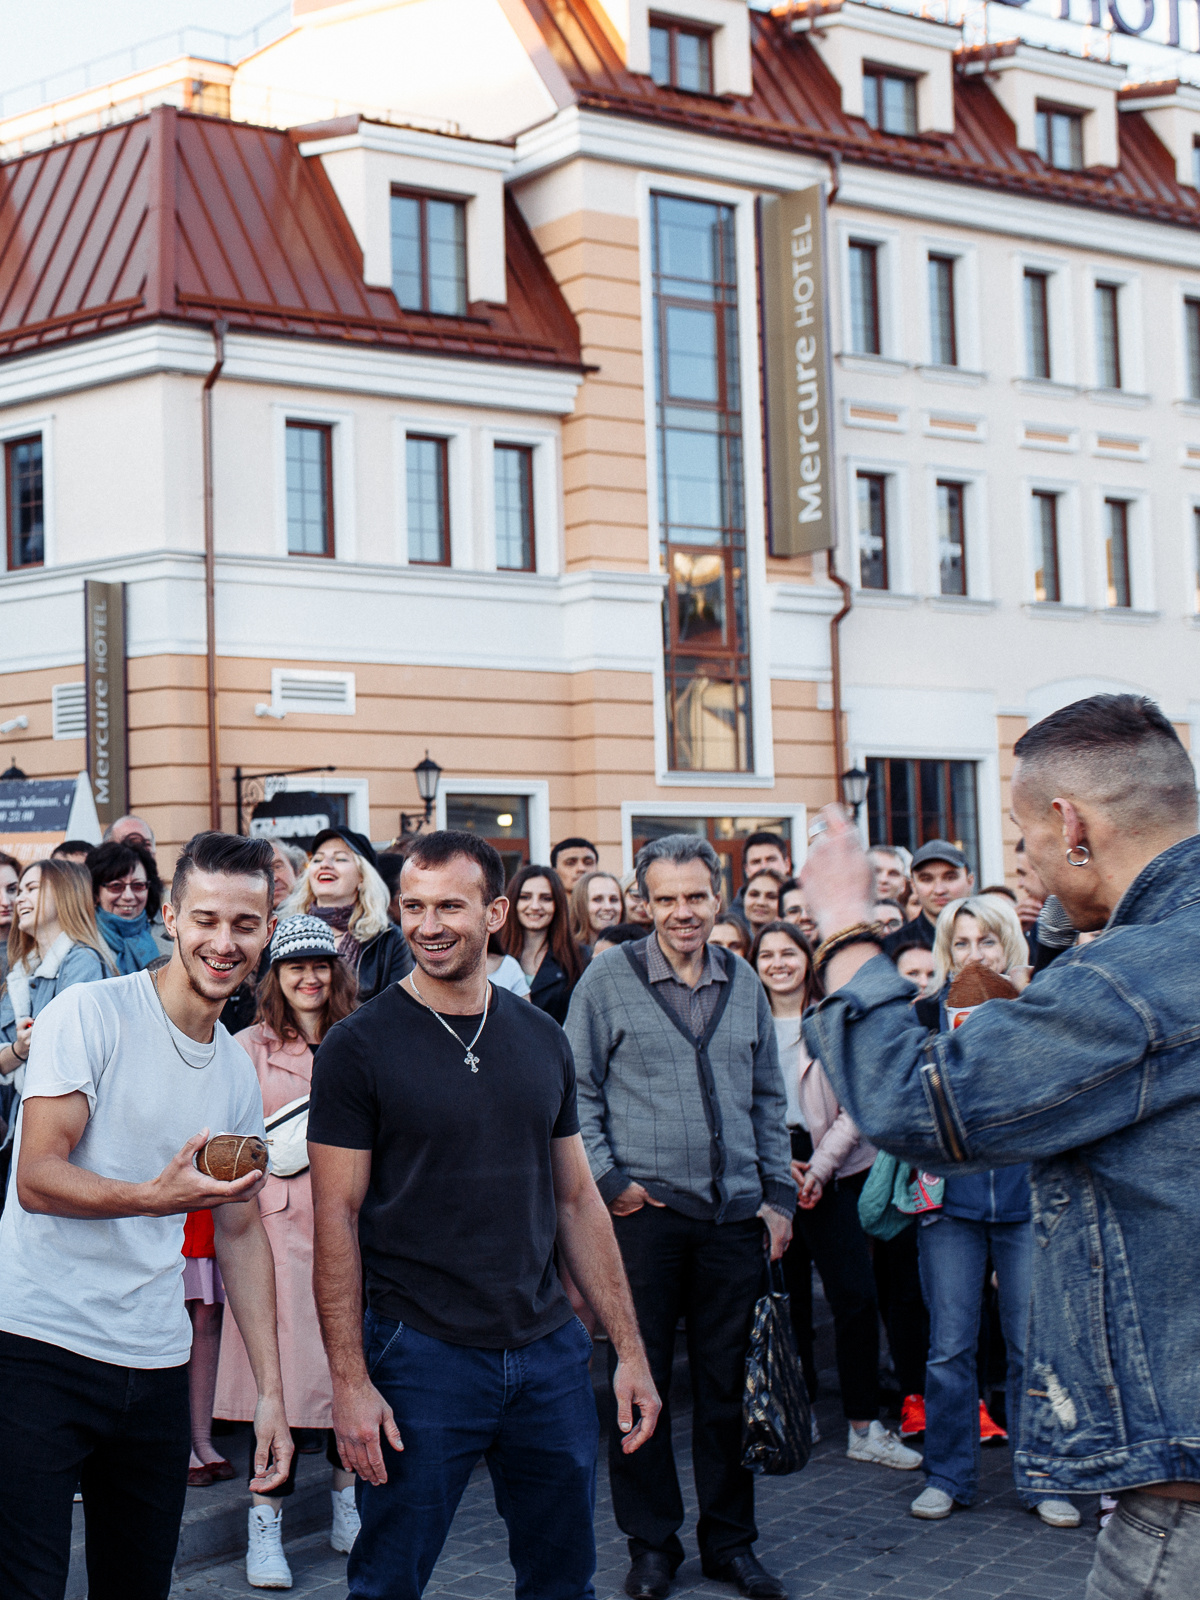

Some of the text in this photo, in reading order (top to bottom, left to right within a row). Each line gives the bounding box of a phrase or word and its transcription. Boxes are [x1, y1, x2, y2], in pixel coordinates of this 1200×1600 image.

[790, 213, 823, 524] Mercure HOTEL
[93, 599, 110, 804] Mercure HOTEL
